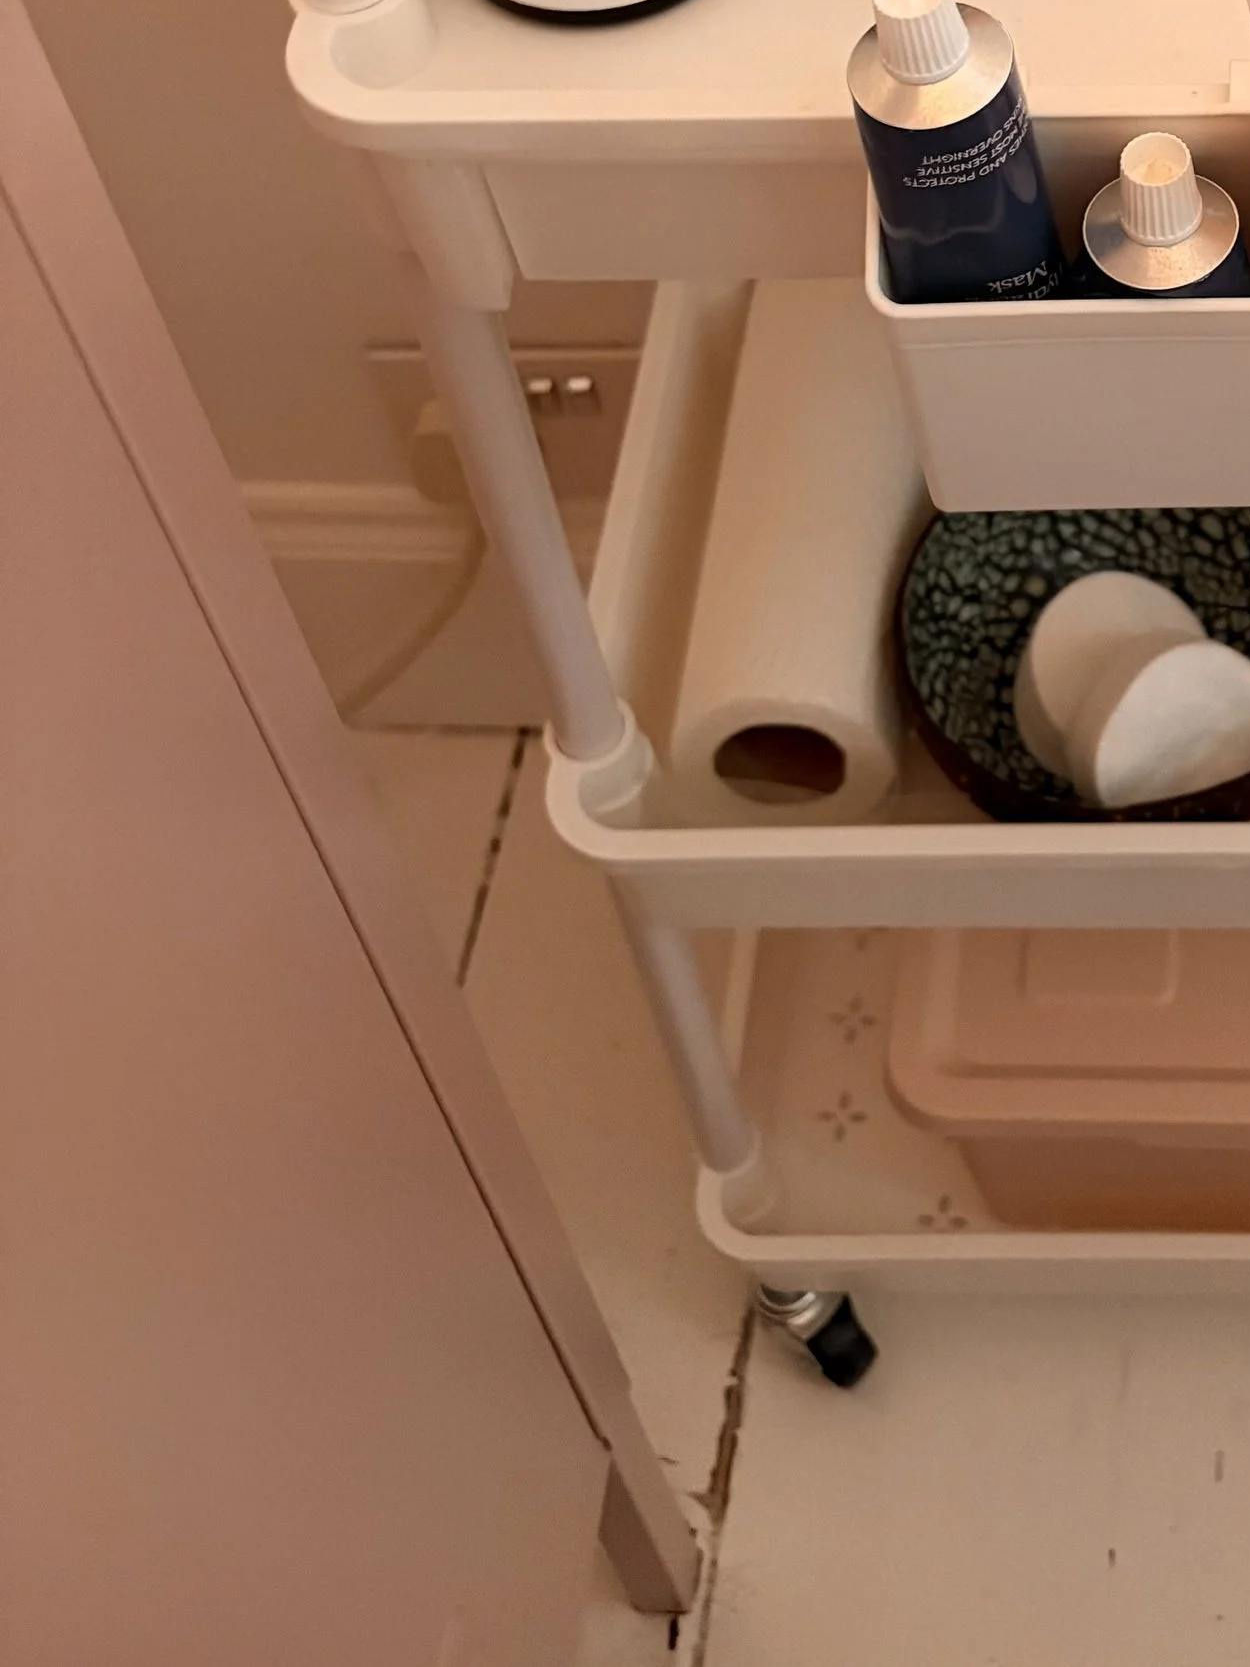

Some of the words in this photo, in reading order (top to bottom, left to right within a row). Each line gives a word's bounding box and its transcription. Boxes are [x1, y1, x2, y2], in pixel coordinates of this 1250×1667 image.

[916, 154, 988, 177] SENSITIVE
[979, 152, 1008, 176] AND
[902, 172, 976, 188] PROTECTS
[986, 260, 1046, 294] Mask
